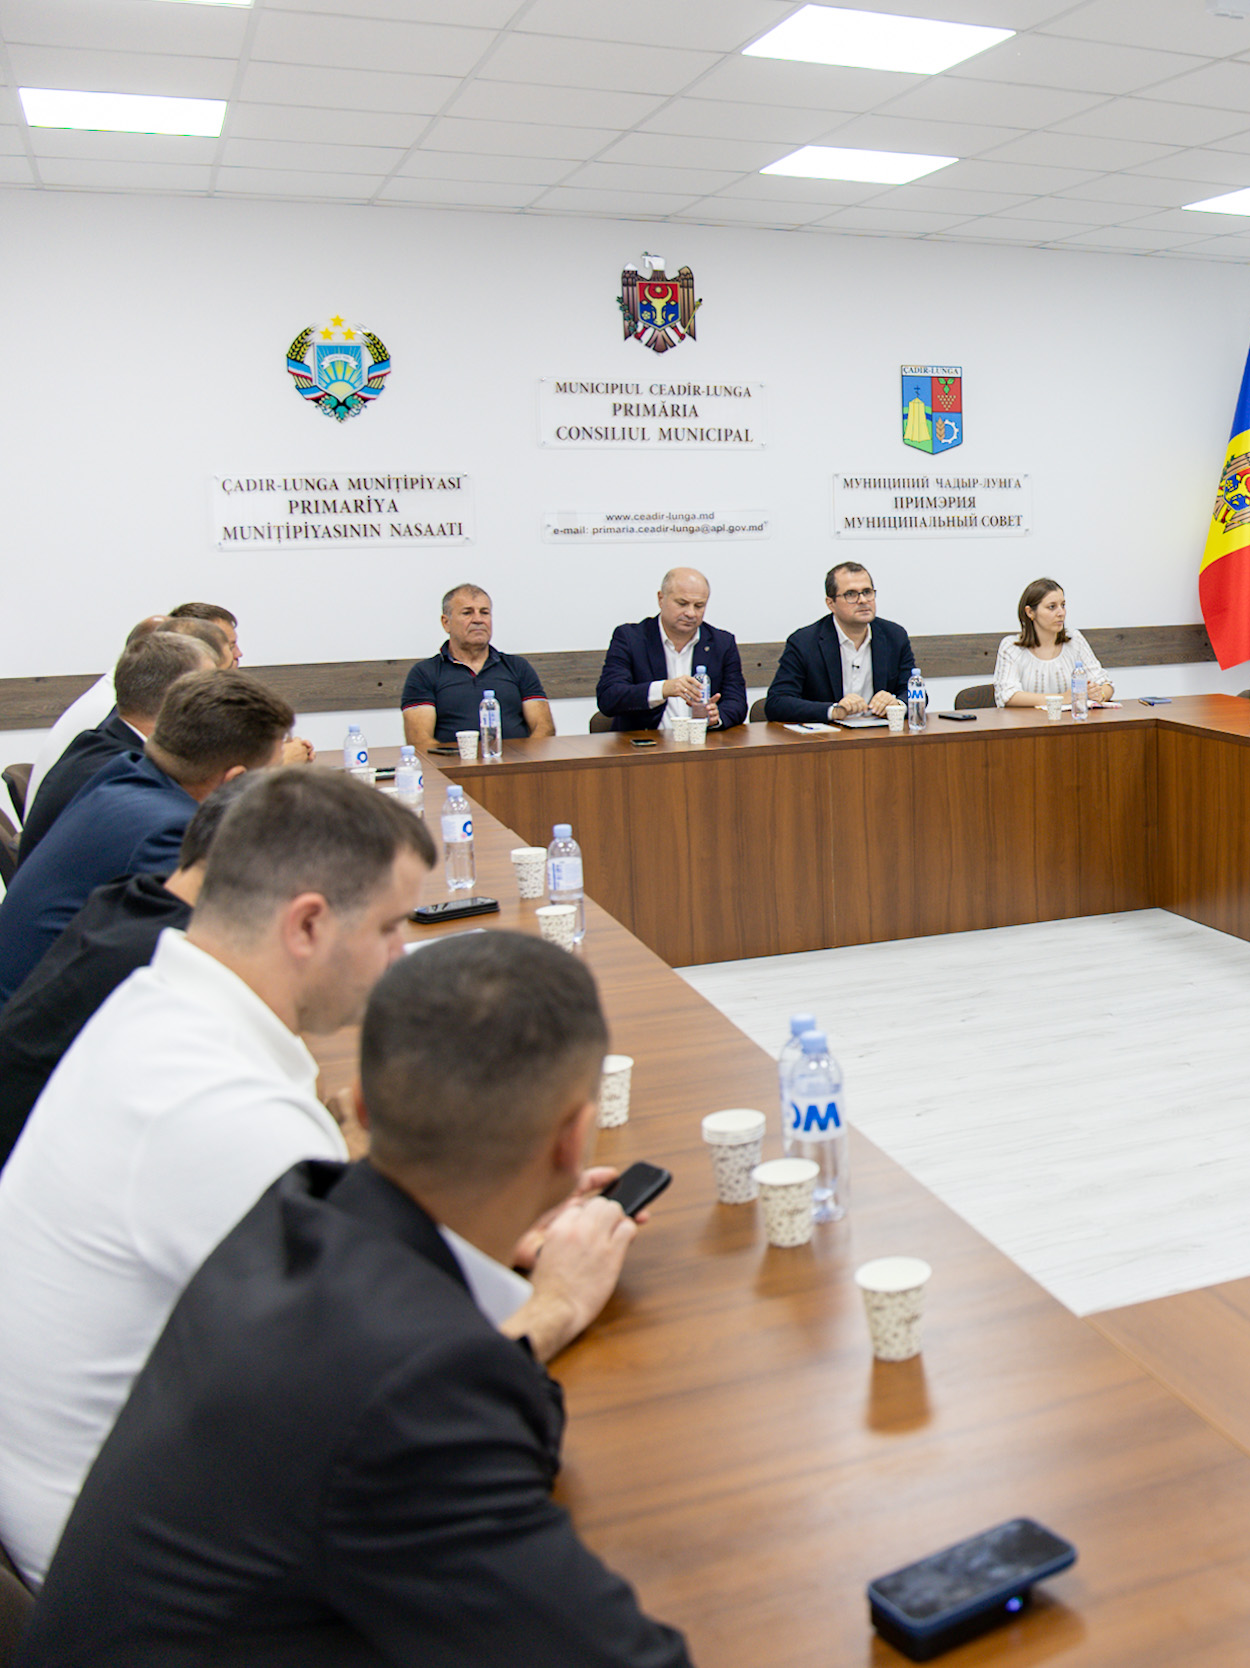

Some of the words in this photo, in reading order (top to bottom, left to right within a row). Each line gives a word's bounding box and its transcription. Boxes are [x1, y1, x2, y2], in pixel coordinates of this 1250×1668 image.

[555, 382, 643, 395] MUNICIPIUL
[650, 382, 752, 398] CEADÎR-LUNGA
[612, 401, 700, 418] PRIMĂRIA
[556, 426, 650, 441] CONSILIUL
[658, 427, 753, 443] MUNICIPAL
[222, 478, 339, 495] ÇADIR-LUNGA
[843, 476, 931, 491] МУНИЦИПИЙ
[935, 477, 1022, 491] ЧАДЫР-ЛУНГА
[288, 495, 399, 514] PRIMARİYA
[894, 496, 977, 510] ПРИМЭРИЯ
[605, 512, 716, 523] www.ceadir-lunga.md
[844, 513, 979, 531] МУНИЦИПАЛЬНЫЙ
[981, 515, 1024, 528] СОВЕТ
[390, 522, 464, 537] NASAATI
[553, 526, 589, 536] e-mail:
